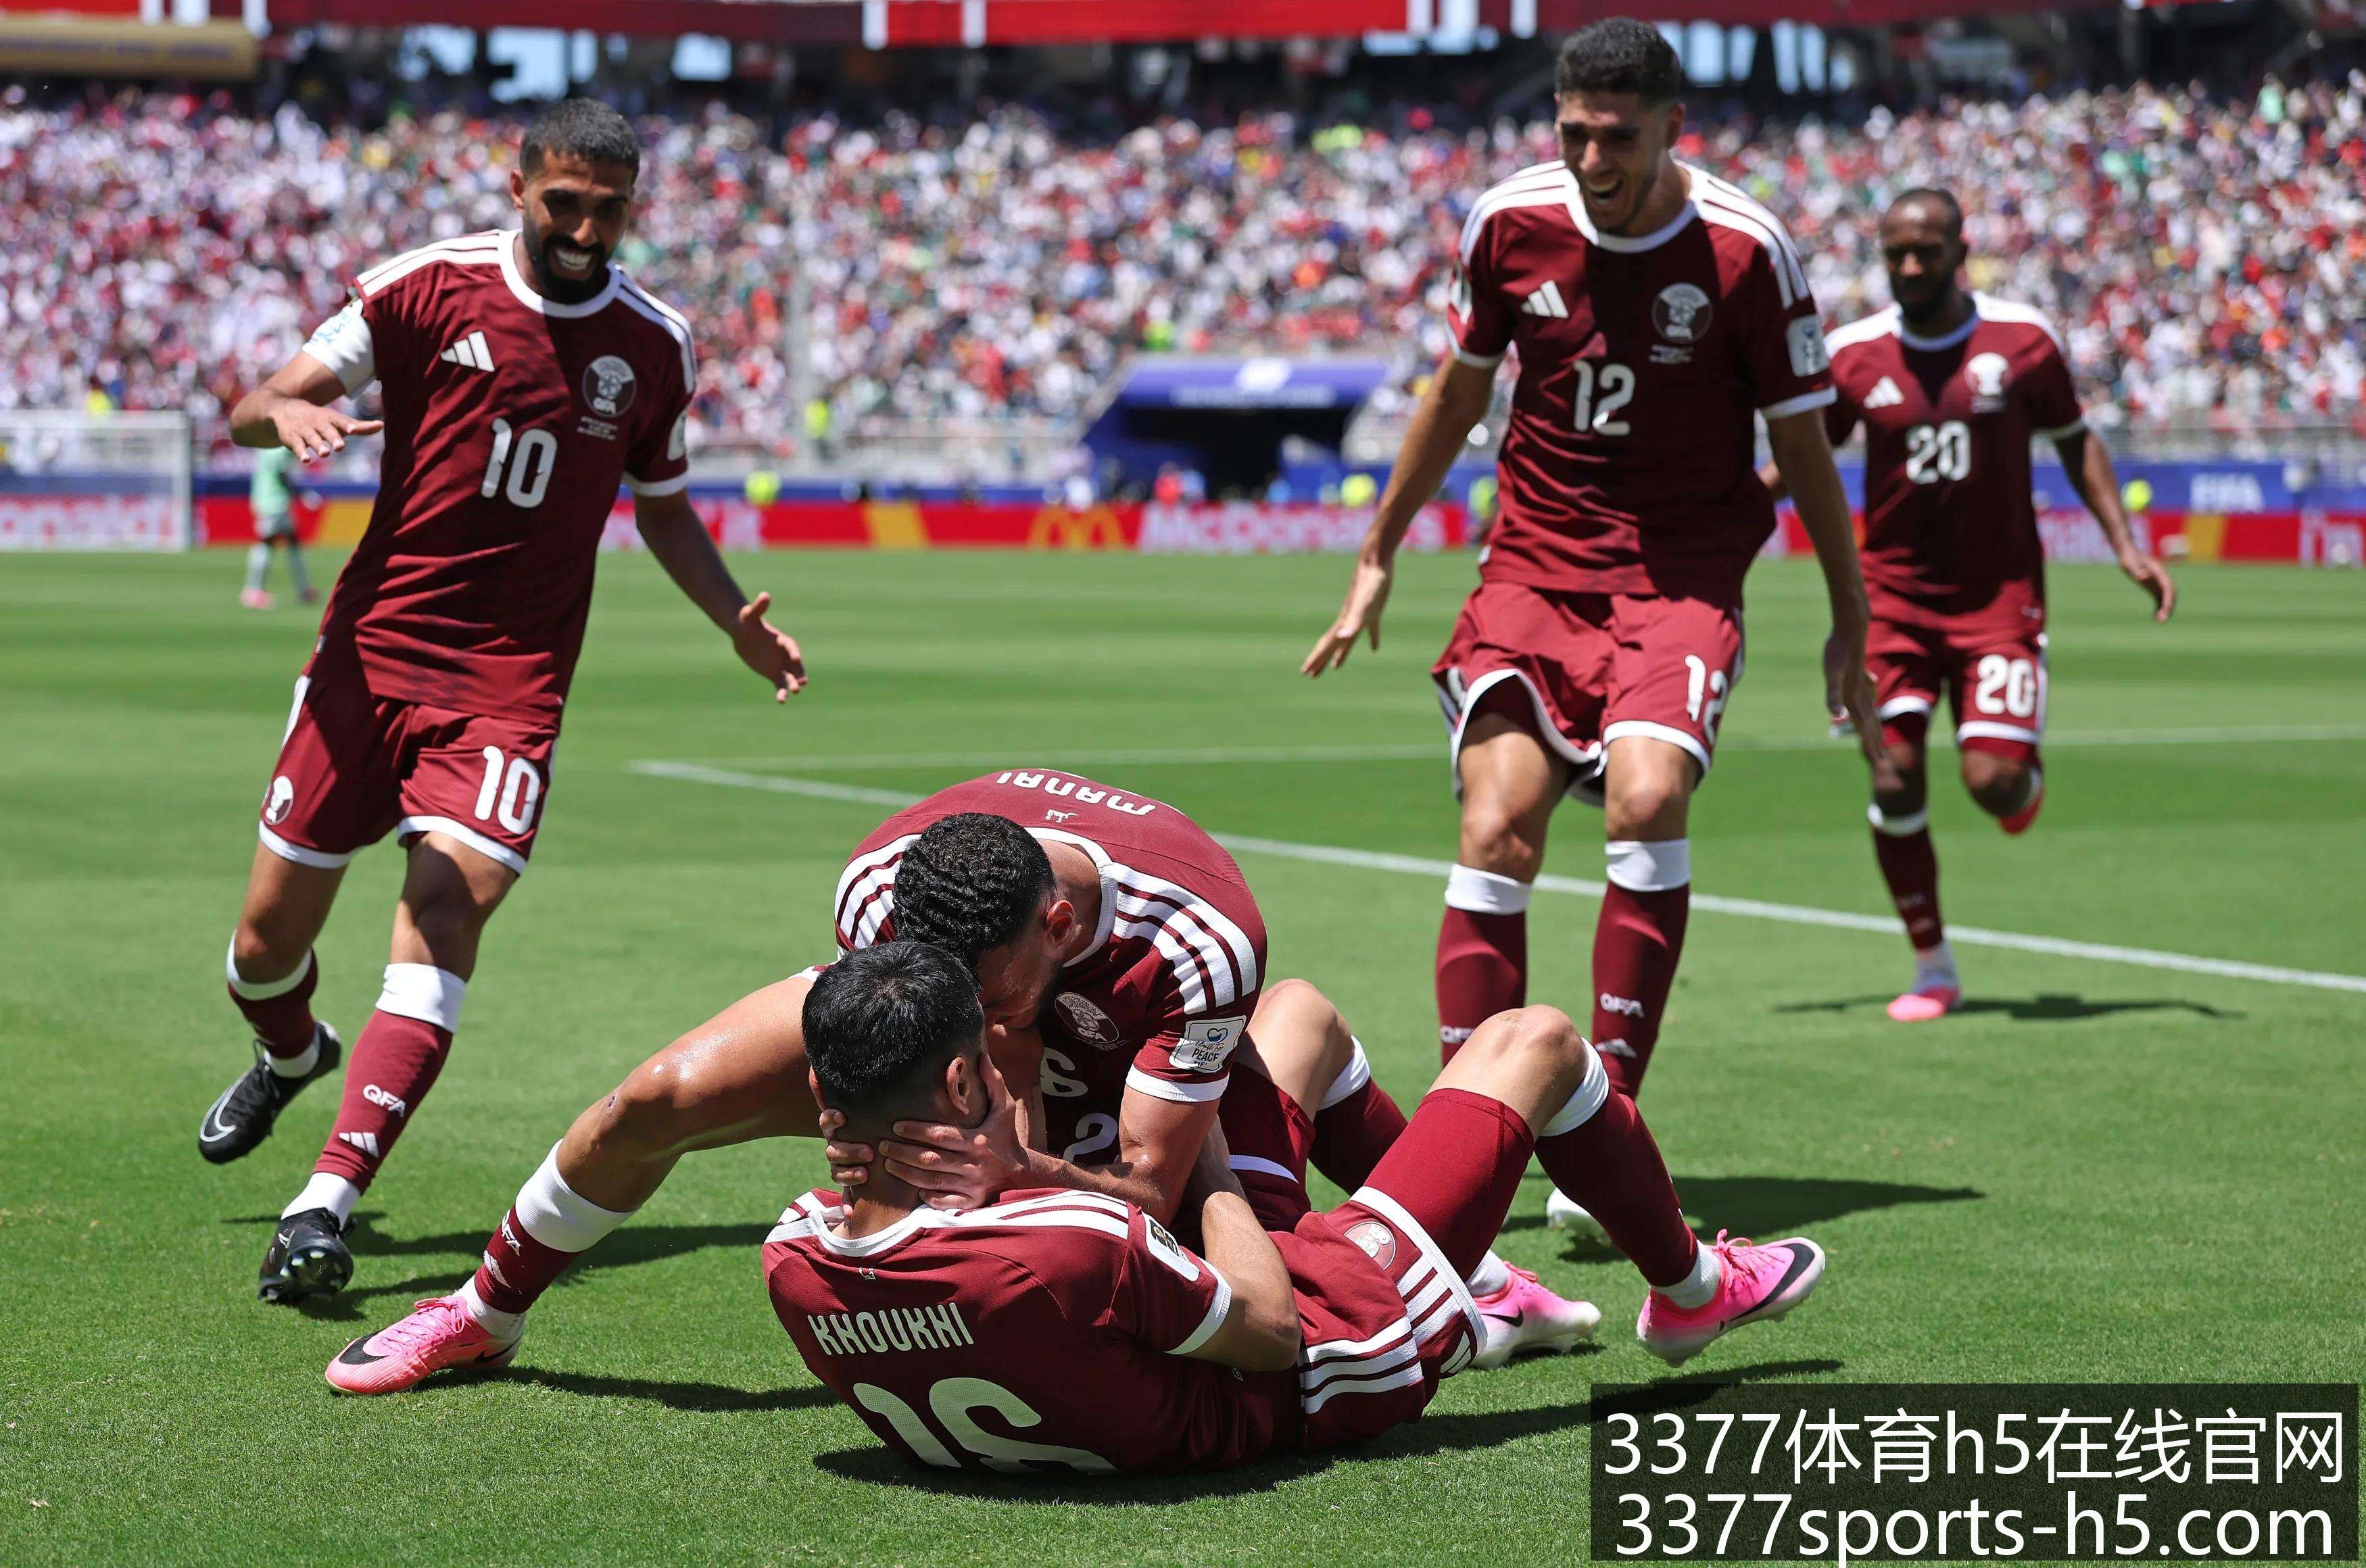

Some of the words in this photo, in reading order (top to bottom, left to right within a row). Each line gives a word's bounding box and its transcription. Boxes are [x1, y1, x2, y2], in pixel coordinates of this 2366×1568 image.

[1572, 360, 1635, 436] 12
[481, 417, 558, 508] 10
[1905, 420, 1971, 485] 20
[1974, 654, 2037, 718] 20
[474, 745, 541, 835] 10
[996, 771, 1156, 816] MANAI
[1600, 992, 1645, 1019] QFA
[363, 1083, 406, 1118] QFA
[807, 1302, 974, 1356] KHOUKHI
[853, 1377, 1119, 1475] 16
